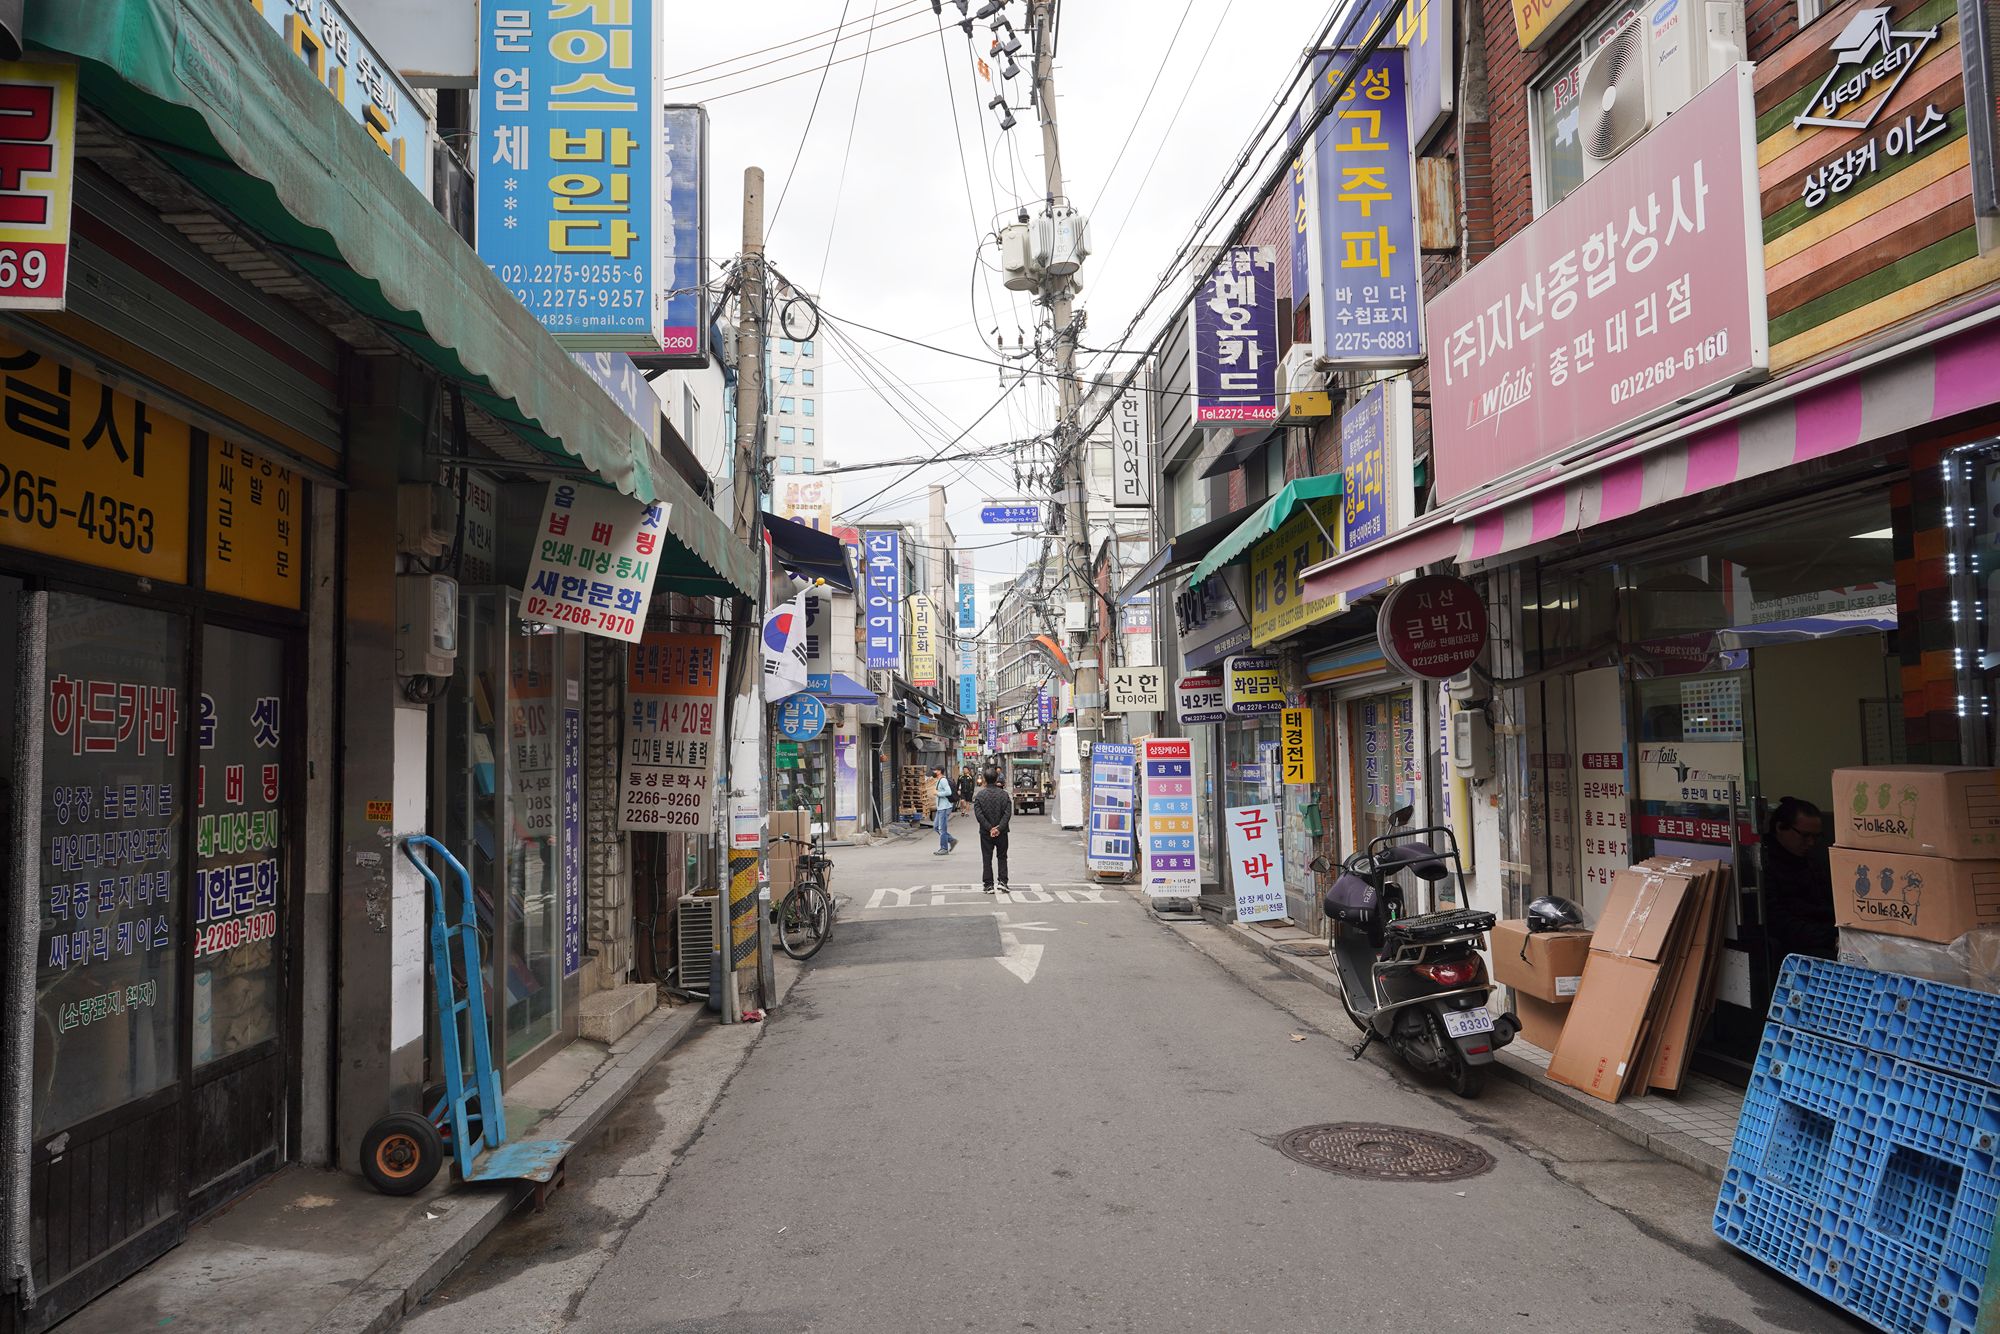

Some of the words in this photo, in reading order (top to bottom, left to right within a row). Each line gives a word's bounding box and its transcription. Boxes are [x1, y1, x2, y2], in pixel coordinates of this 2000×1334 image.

[1822, 42, 1911, 117] yegreen
[548, 128, 640, 260] 바인다
[1335, 109, 1397, 278] 고주파
[1335, 285, 1406, 304] 바인다
[1336, 306, 1408, 325] 수첩표지
[1549, 329, 1596, 387] 총판
[1605, 273, 1691, 355] 대리점
[1335, 331, 1412, 350] 2275-6881
[1610, 327, 1729, 404] 02)2268-6160
[1201, 408, 1278, 420] Tel.2272-4468
[1004, 508, 1037, 517] 충무로4길
[530, 569, 643, 615] 새한문화
[869, 535, 896, 654] 신우다이어리
[1415, 588, 1455, 609] 지산
[527, 596, 636, 636] 02-2268-7970
[1406, 610, 1473, 639] 금박지
[1439, 632, 1479, 648] 판매대리점
[1412, 648, 1476, 667] 02)2268-6160
[1113, 674, 1159, 694] 신한
[1115, 694, 1158, 705] 다이어리
[1181, 692, 1224, 710] 네오카드
[50, 673, 179, 757] 하드카바
[681, 701, 713, 735] 20원
[632, 738, 662, 764] 디지털
[666, 741, 685, 765] 복사
[688, 740, 708, 766] 출력
[1094, 744, 1134, 754] 신한다이어리
[1149, 746, 1187, 755] 상장케이스
[1285, 711, 1304, 780] 태경전기
[1157, 764, 1182, 773] 금박
[1587, 752, 1618, 769] 취급품목
[199, 763, 280, 805] 버링
[629, 771, 708, 790] 동성문화사
[1158, 783, 1183, 793] 상장
[627, 790, 701, 807] 2266-9260
[1681, 787, 1708, 800] 총판매
[626, 808, 700, 826] 2268-9260
[1853, 817, 1909, 836] 상장케이스
[1154, 839, 1190, 848] 연하장
[1234, 809, 1274, 887] 금박
[1155, 858, 1191, 867] 상품권
[1238, 892, 1283, 905] 상장케이스
[1856, 899, 1913, 920] 상장케이스
[49, 927, 109, 971] 싸바리
[117, 914, 169, 957] 케이스
[1459, 1016, 1489, 1032] 8330
